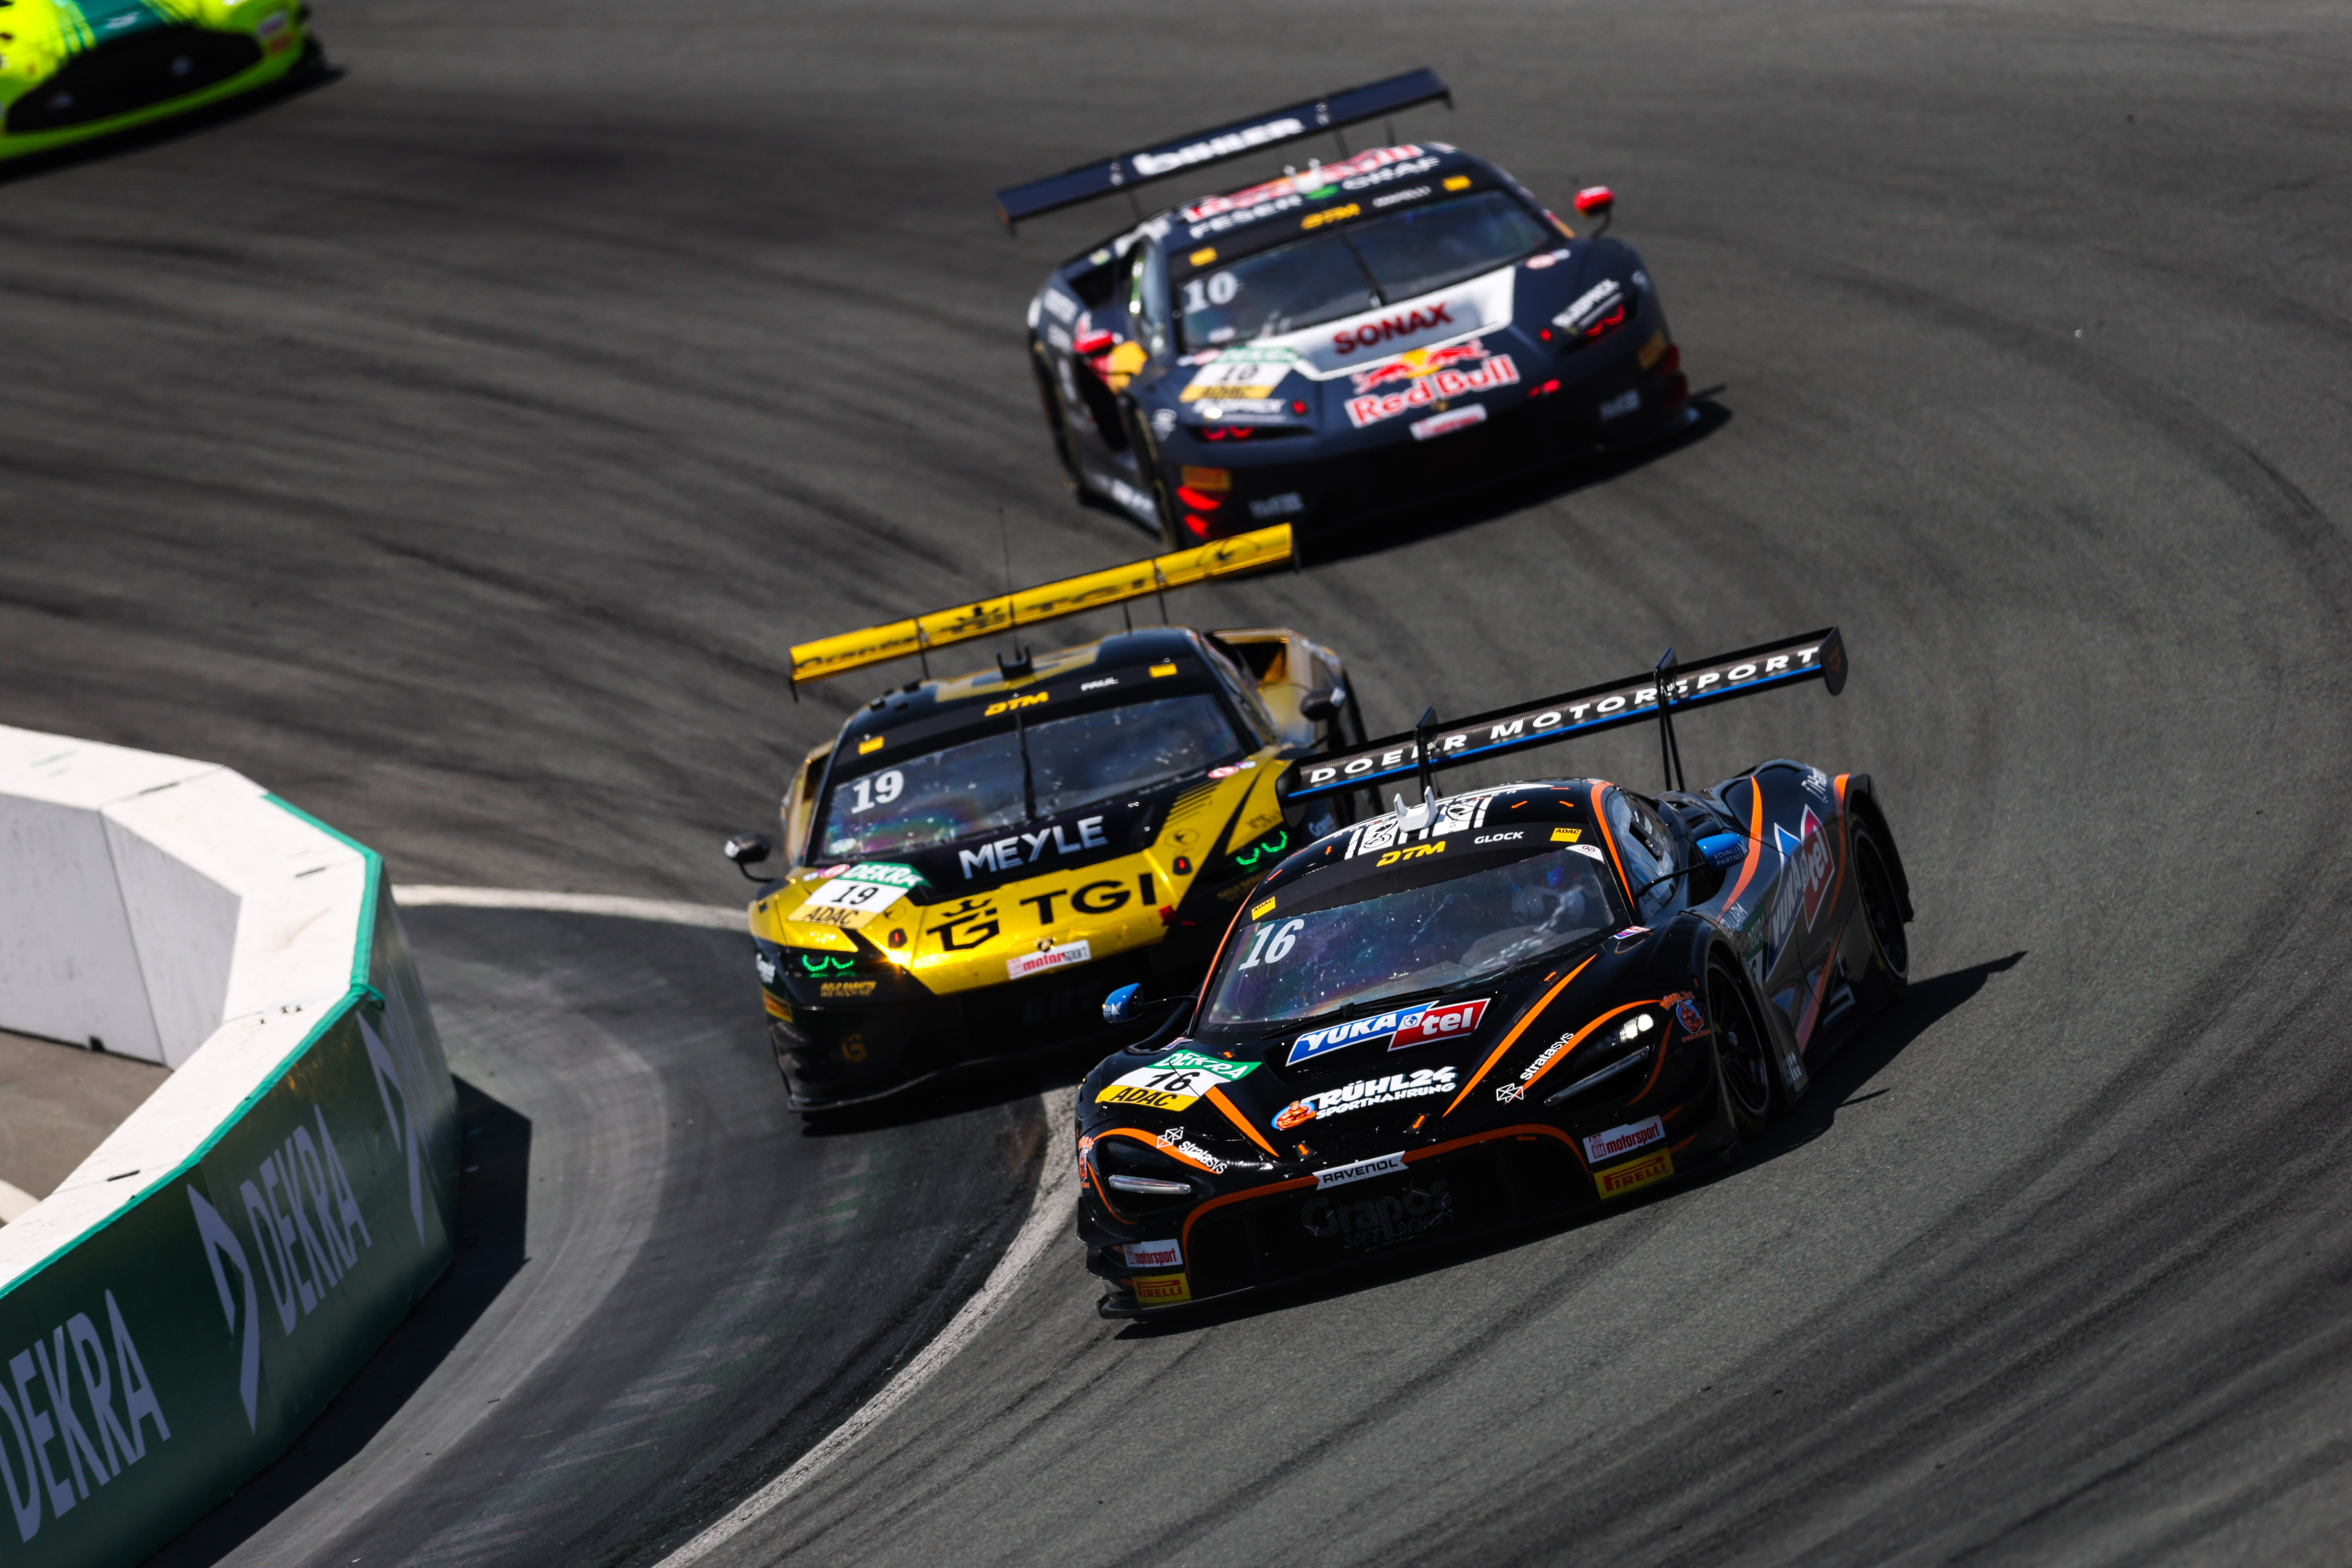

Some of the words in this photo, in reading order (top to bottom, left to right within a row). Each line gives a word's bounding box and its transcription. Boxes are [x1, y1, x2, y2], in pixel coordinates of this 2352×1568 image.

[1189, 194, 1303, 239] FESER
[1342, 156, 1441, 190] GRAF
[1301, 202, 1360, 230] DTM
[1183, 271, 1239, 313] 10
[1332, 302, 1455, 355] SONAX
[1346, 377, 1435, 428] Red
[1431, 355, 1520, 398] Bull
[984, 691, 1049, 717] DTM
[1490, 647, 1819, 739] MOTORSPORT
[852, 770, 905, 814] 19
[959, 815, 1108, 880] MEYLE
[1376, 841, 1446, 867] DTM
[1474, 831, 1525, 844] GLOCK
[1714, 846, 1738, 860] KOHNLE
[843, 864, 924, 887] DEKRA
[1716, 852, 1744, 866] PARTNER
[1808, 825, 1828, 893] tel
[831, 885, 879, 905] 19
[1020, 873, 1157, 924] TGI
[1253, 898, 1274, 913] ADAC
[803, 906, 859, 925] ADAC
[1239, 919, 1304, 971] 16
[1301, 1012, 1397, 1051] YUKA
[1422, 1007, 1474, 1036] tel
[1154, 1052, 1248, 1079] DEKRA
[1520, 1033, 1574, 1080] stratasys
[1108, 1087, 1178, 1107] ADAC
[1144, 1072, 1201, 1092] 16
[1301, 1066, 1458, 1109] RÜHL24
[1316, 1082, 1457, 1119] SPORTNAHRUNG
[1606, 1123, 1660, 1155] motorsport
[1179, 1141, 1228, 1174] stratasys
[1322, 1159, 1398, 1184] RAVENOL
[1603, 1155, 1667, 1192] PIRELLI
[240, 1103, 372, 1336] DEKRA
[1134, 1248, 1177, 1266] motorsport
[1135, 1279, 1183, 1298] PIRELLI
[0, 1289, 171, 1542] DEKRA
